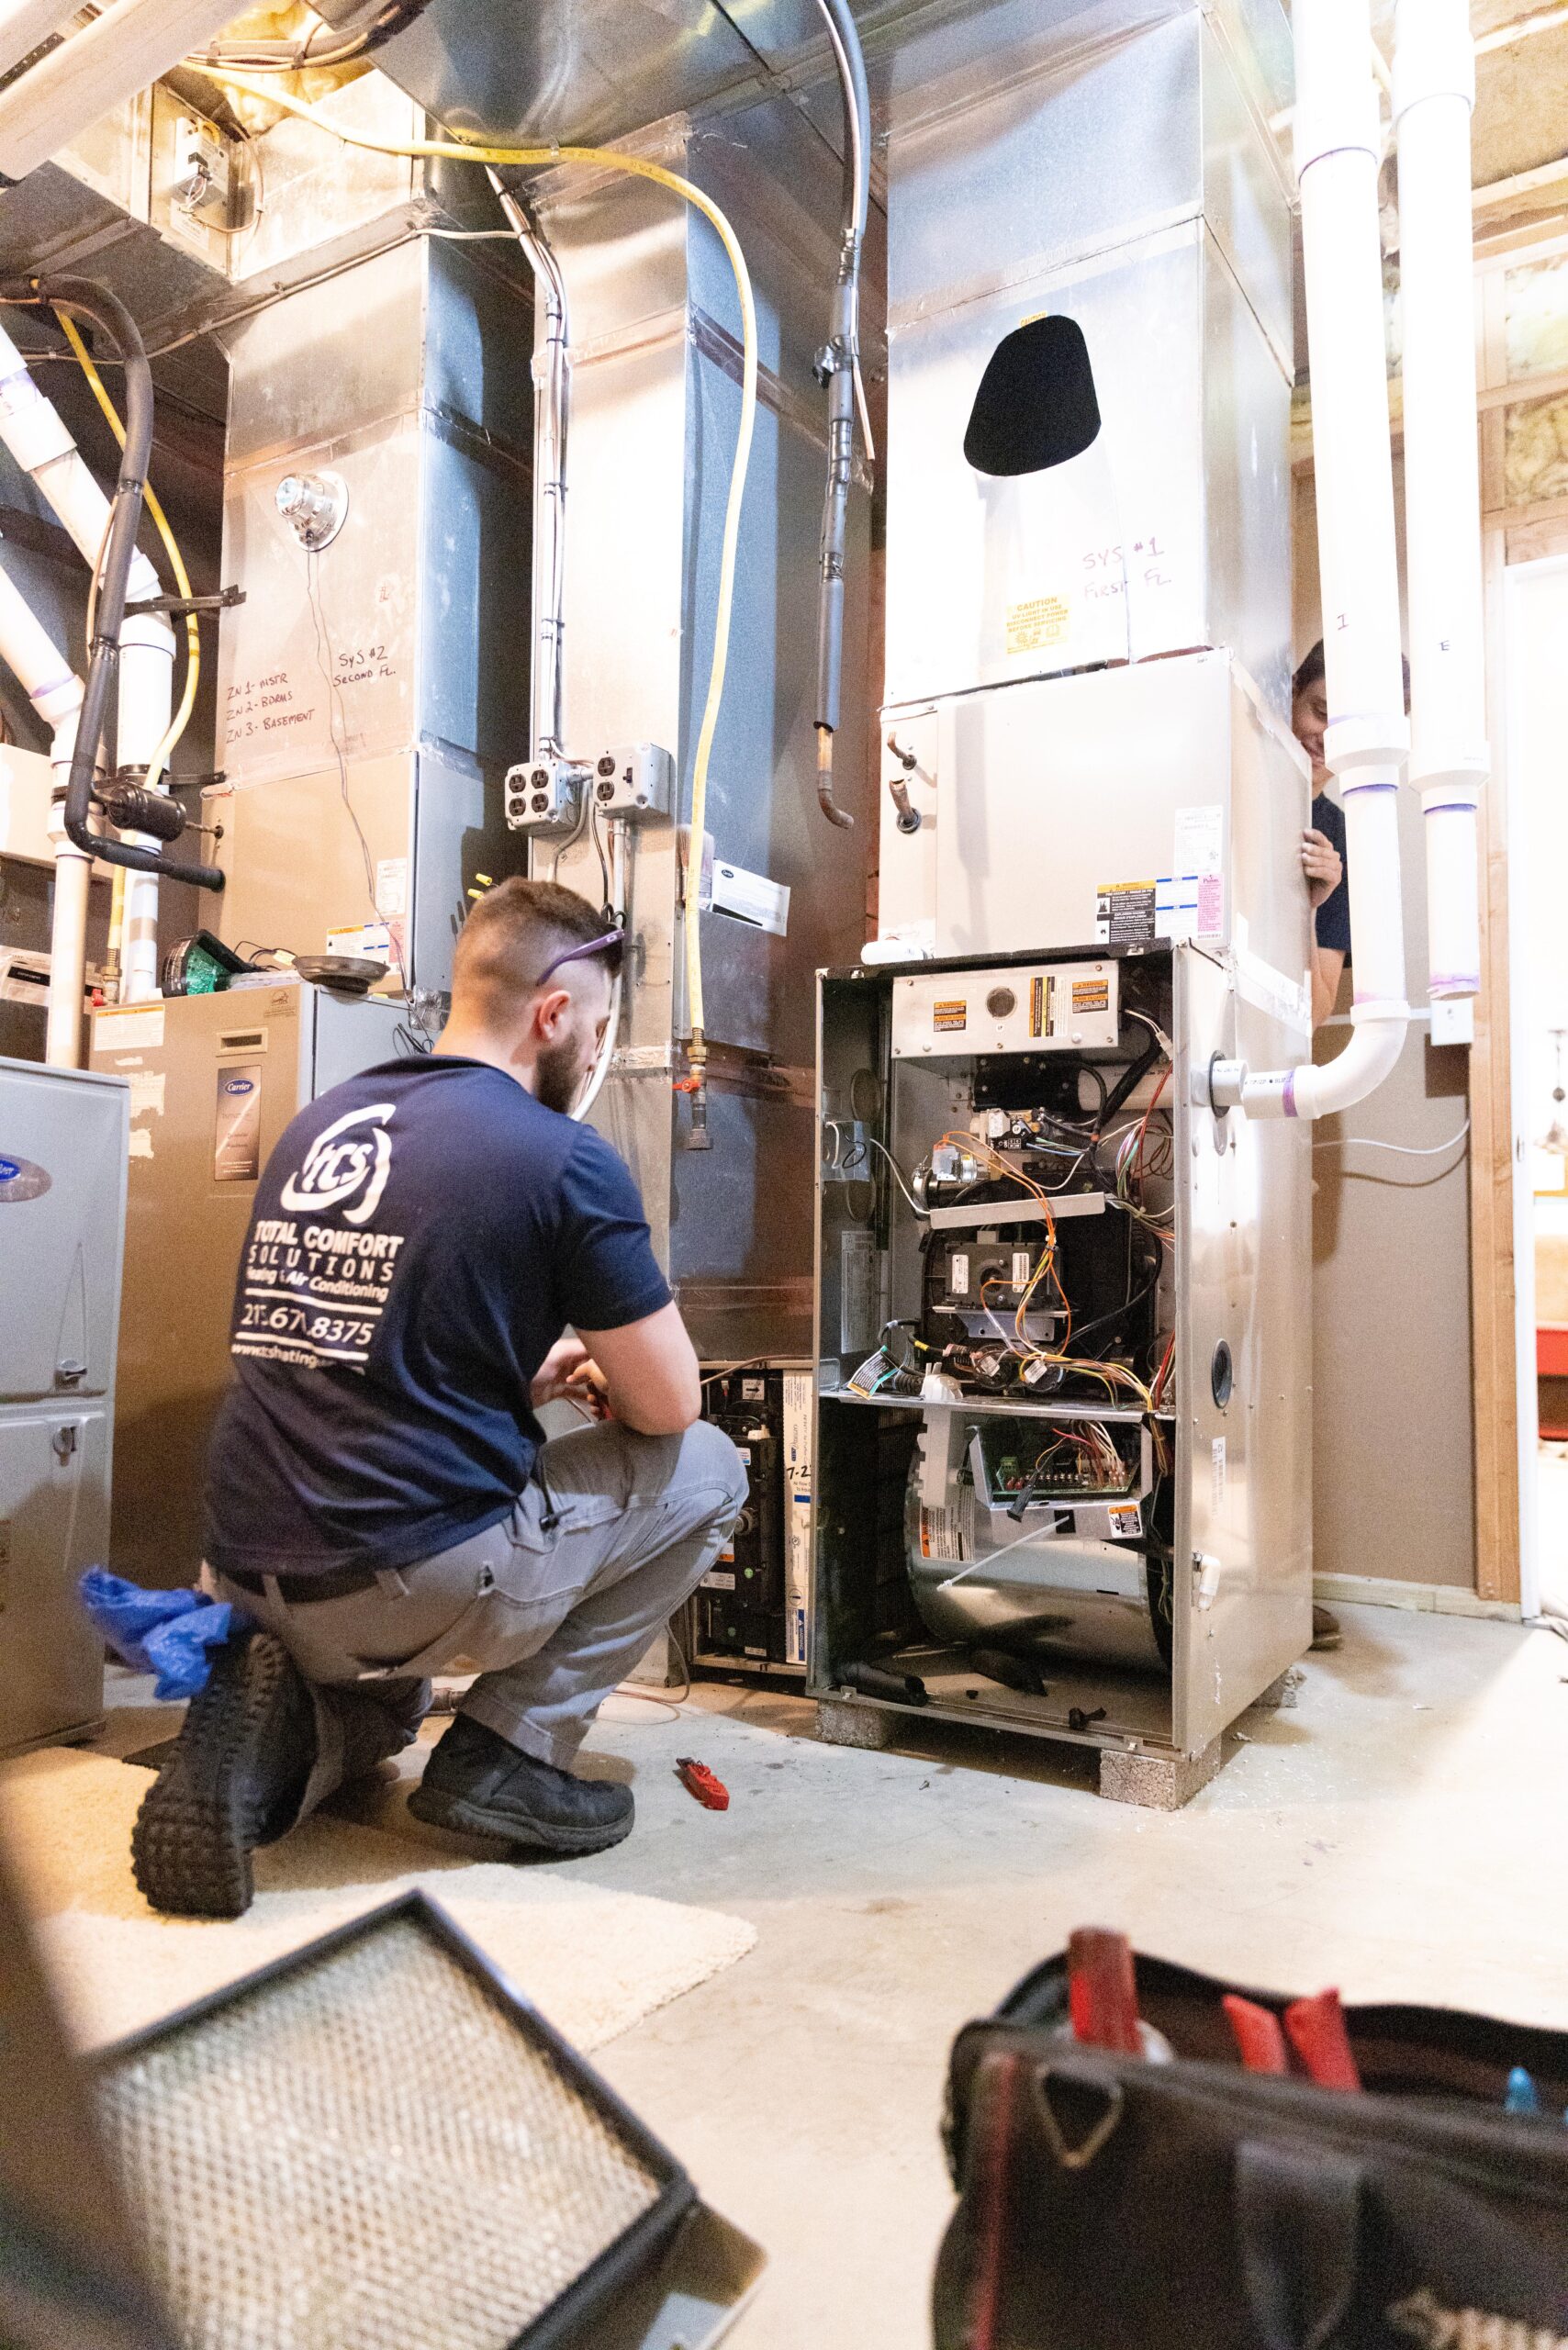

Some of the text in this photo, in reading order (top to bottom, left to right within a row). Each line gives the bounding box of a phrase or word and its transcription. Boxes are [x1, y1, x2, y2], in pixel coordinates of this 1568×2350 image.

[1082, 545, 1123, 569] SYS
[1016, 597, 1058, 611] CAUTION
[1047, 610, 1069, 618] POWER
[1439, 640, 1450, 652] E
[263, 709, 316, 730] BASEMENT
[228, 1082, 252, 1091] Carrier
[254, 1220, 404, 1259] TOTAL COMFORT
[248, 1244, 395, 1282] SOLUTIONS
[286, 1270, 309, 1287] Air
[308, 1275, 389, 1303] Conditioning
[786, 1465, 812, 1480] 7-2
